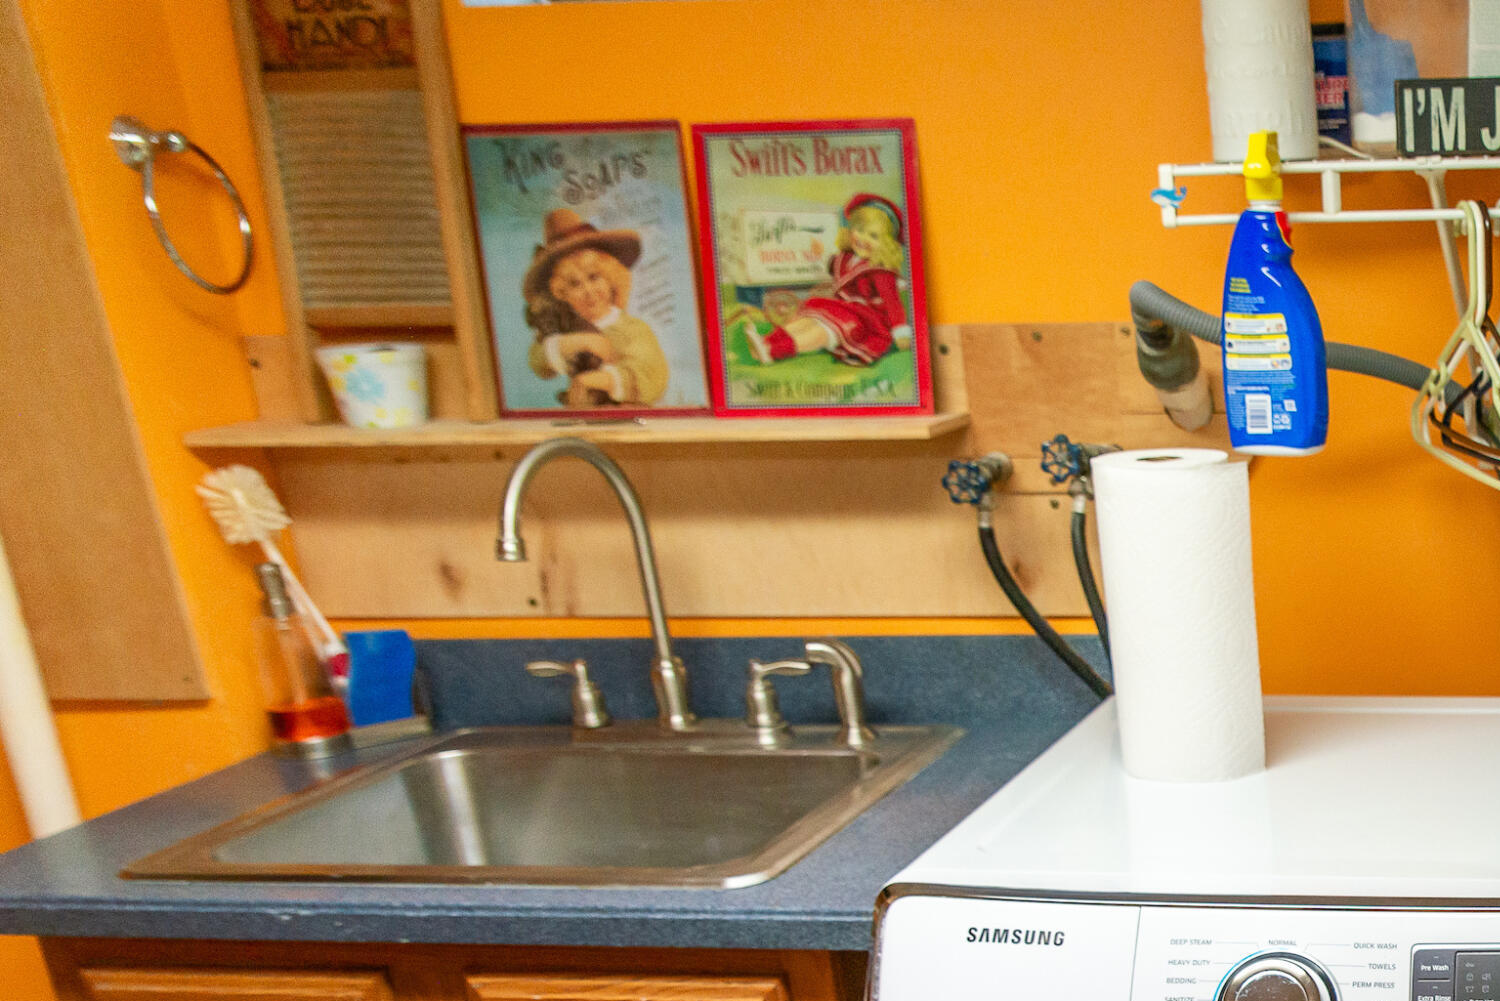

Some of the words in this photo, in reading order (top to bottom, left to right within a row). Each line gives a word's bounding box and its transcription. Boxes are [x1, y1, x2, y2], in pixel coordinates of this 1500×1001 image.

[1403, 86, 1467, 153] I'M
[813, 137, 884, 176] Borax
[966, 926, 1066, 947] SAMSUNG
[1190, 938, 1212, 946] STEAM
[1166, 977, 1198, 985] BEDDING
